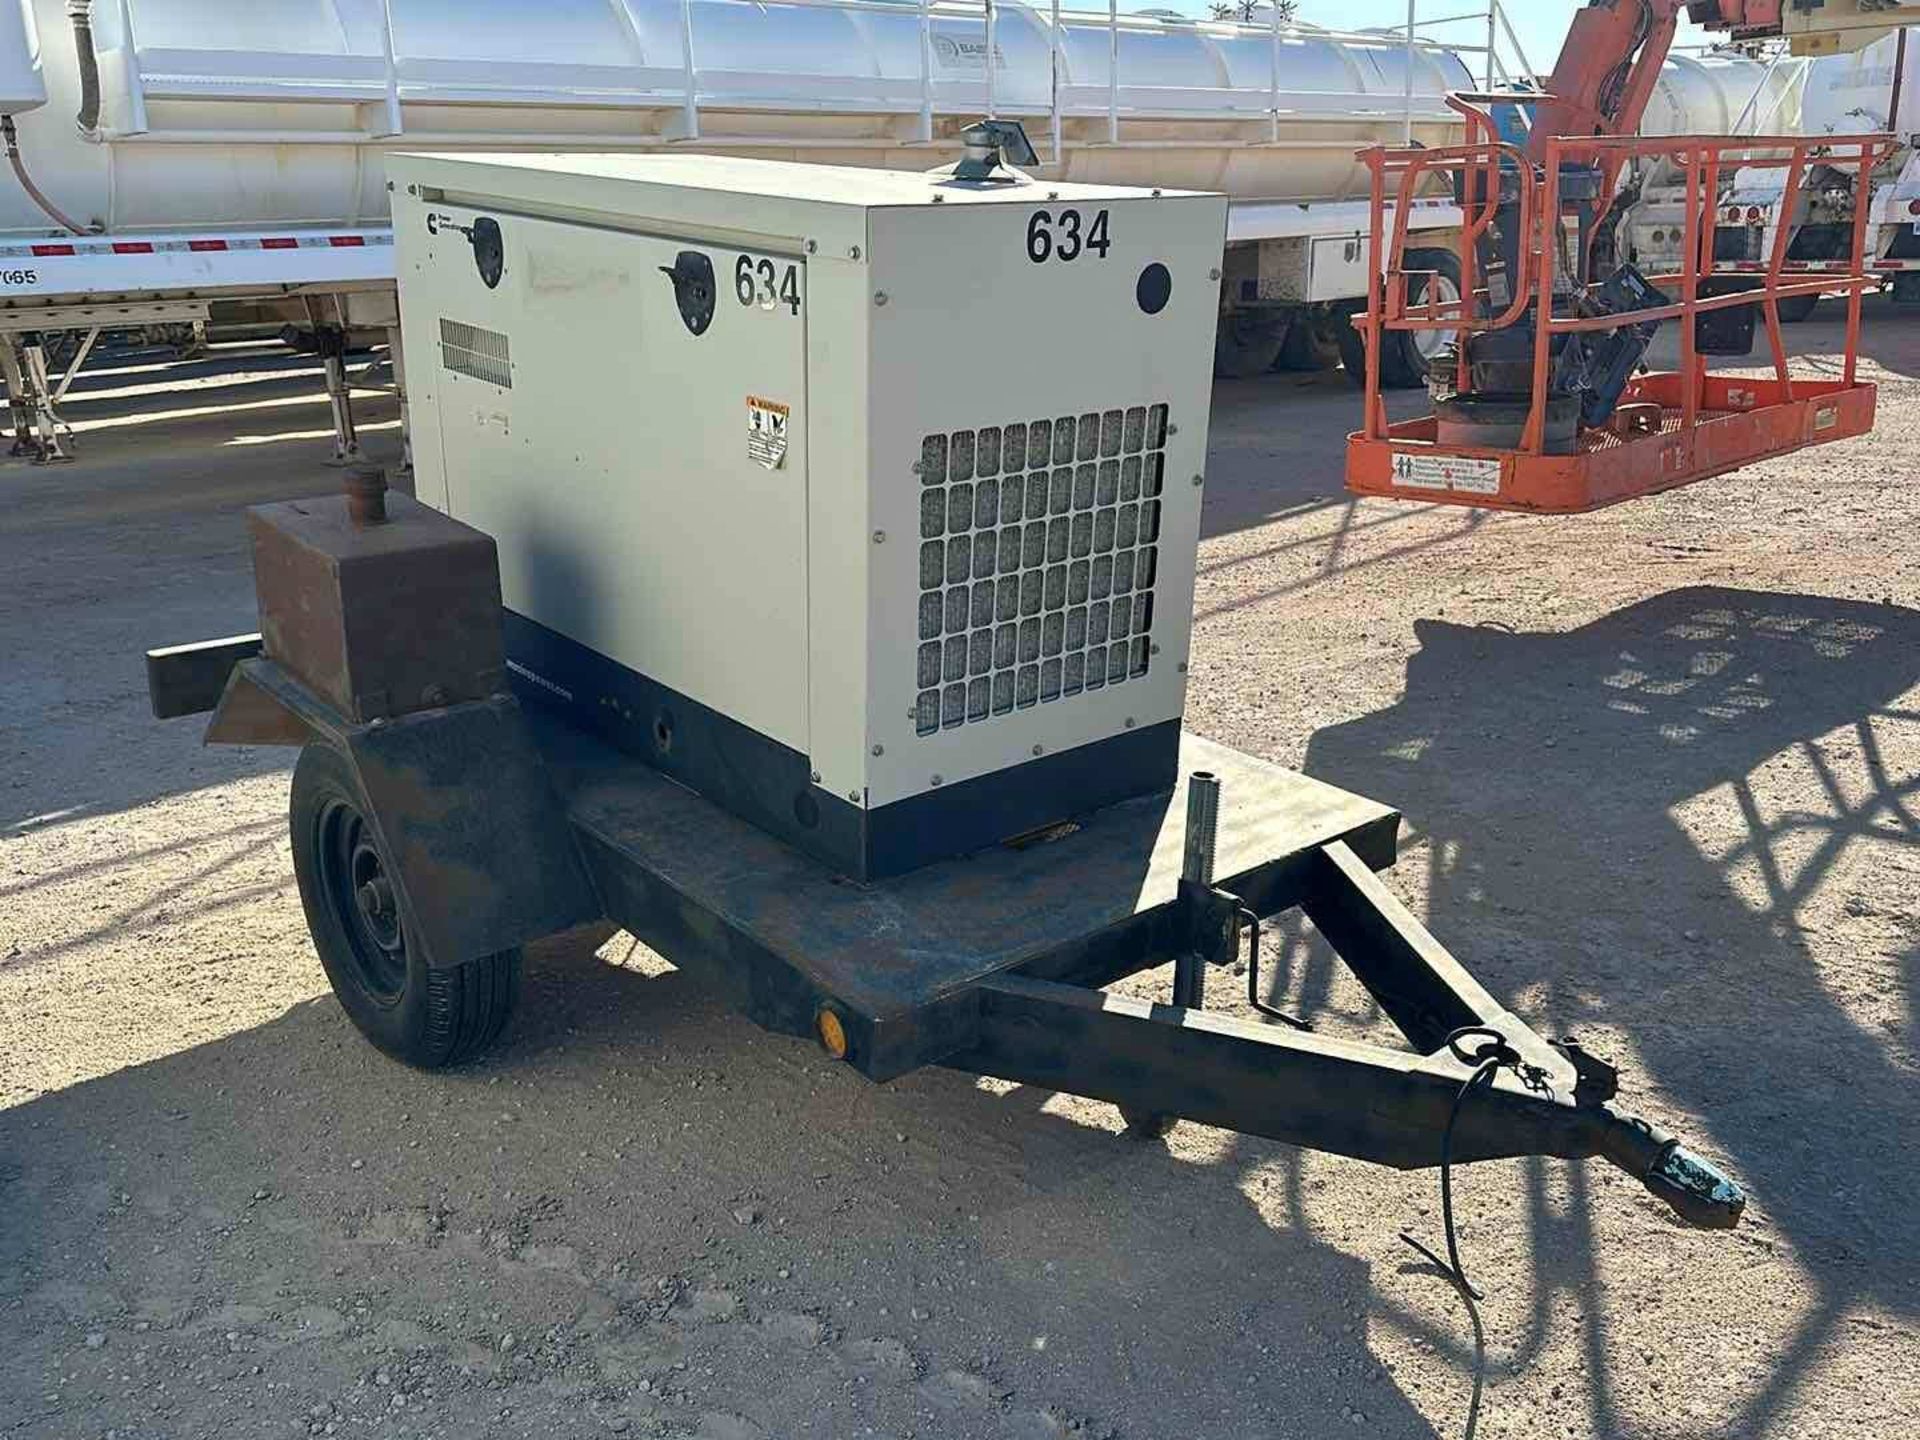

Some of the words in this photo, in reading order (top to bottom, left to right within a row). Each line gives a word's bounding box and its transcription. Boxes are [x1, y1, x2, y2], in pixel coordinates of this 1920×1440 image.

[1027, 209, 1110, 263] 634
[0, 270, 37, 285] 065
[736, 254, 800, 316] 634
